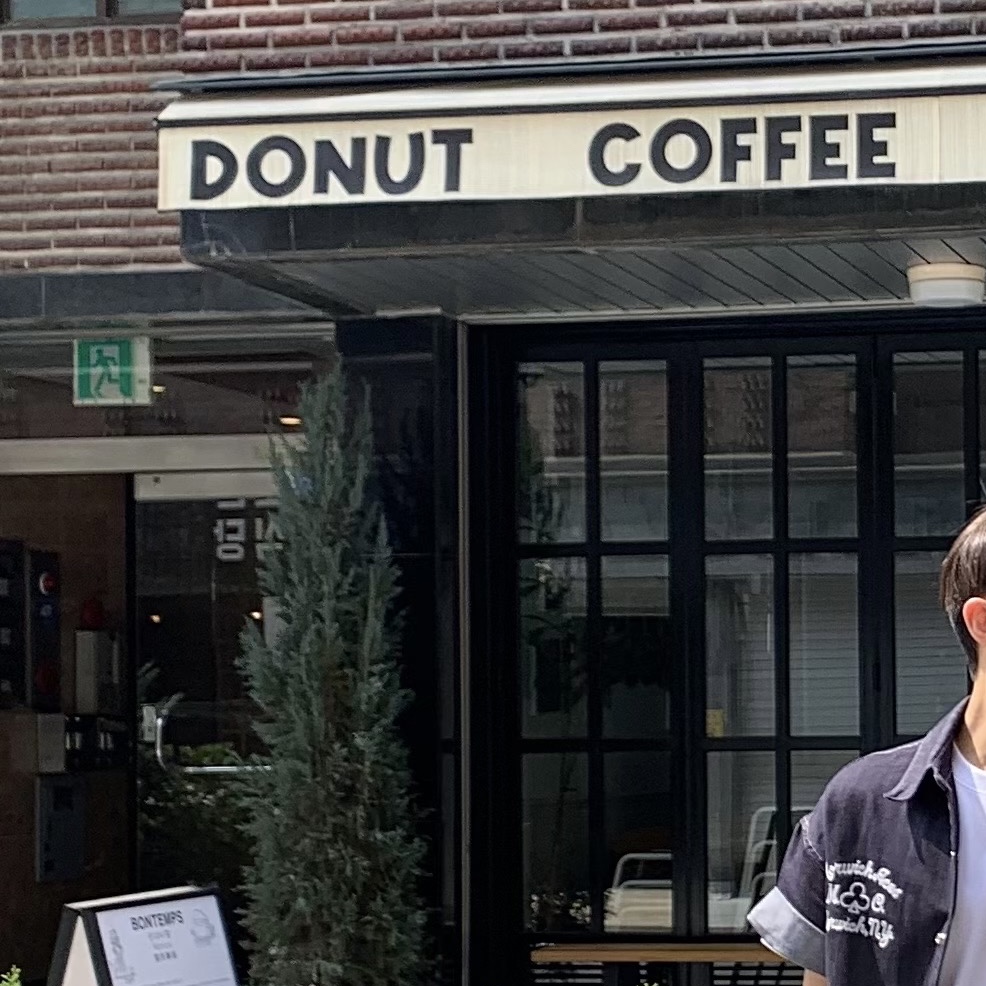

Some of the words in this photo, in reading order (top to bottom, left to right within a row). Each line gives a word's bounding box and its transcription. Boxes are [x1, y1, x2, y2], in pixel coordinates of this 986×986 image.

[190, 128, 474, 201] DONUT
[588, 111, 897, 187] COFFEE
[130, 910, 184, 931] BONTEMPS
